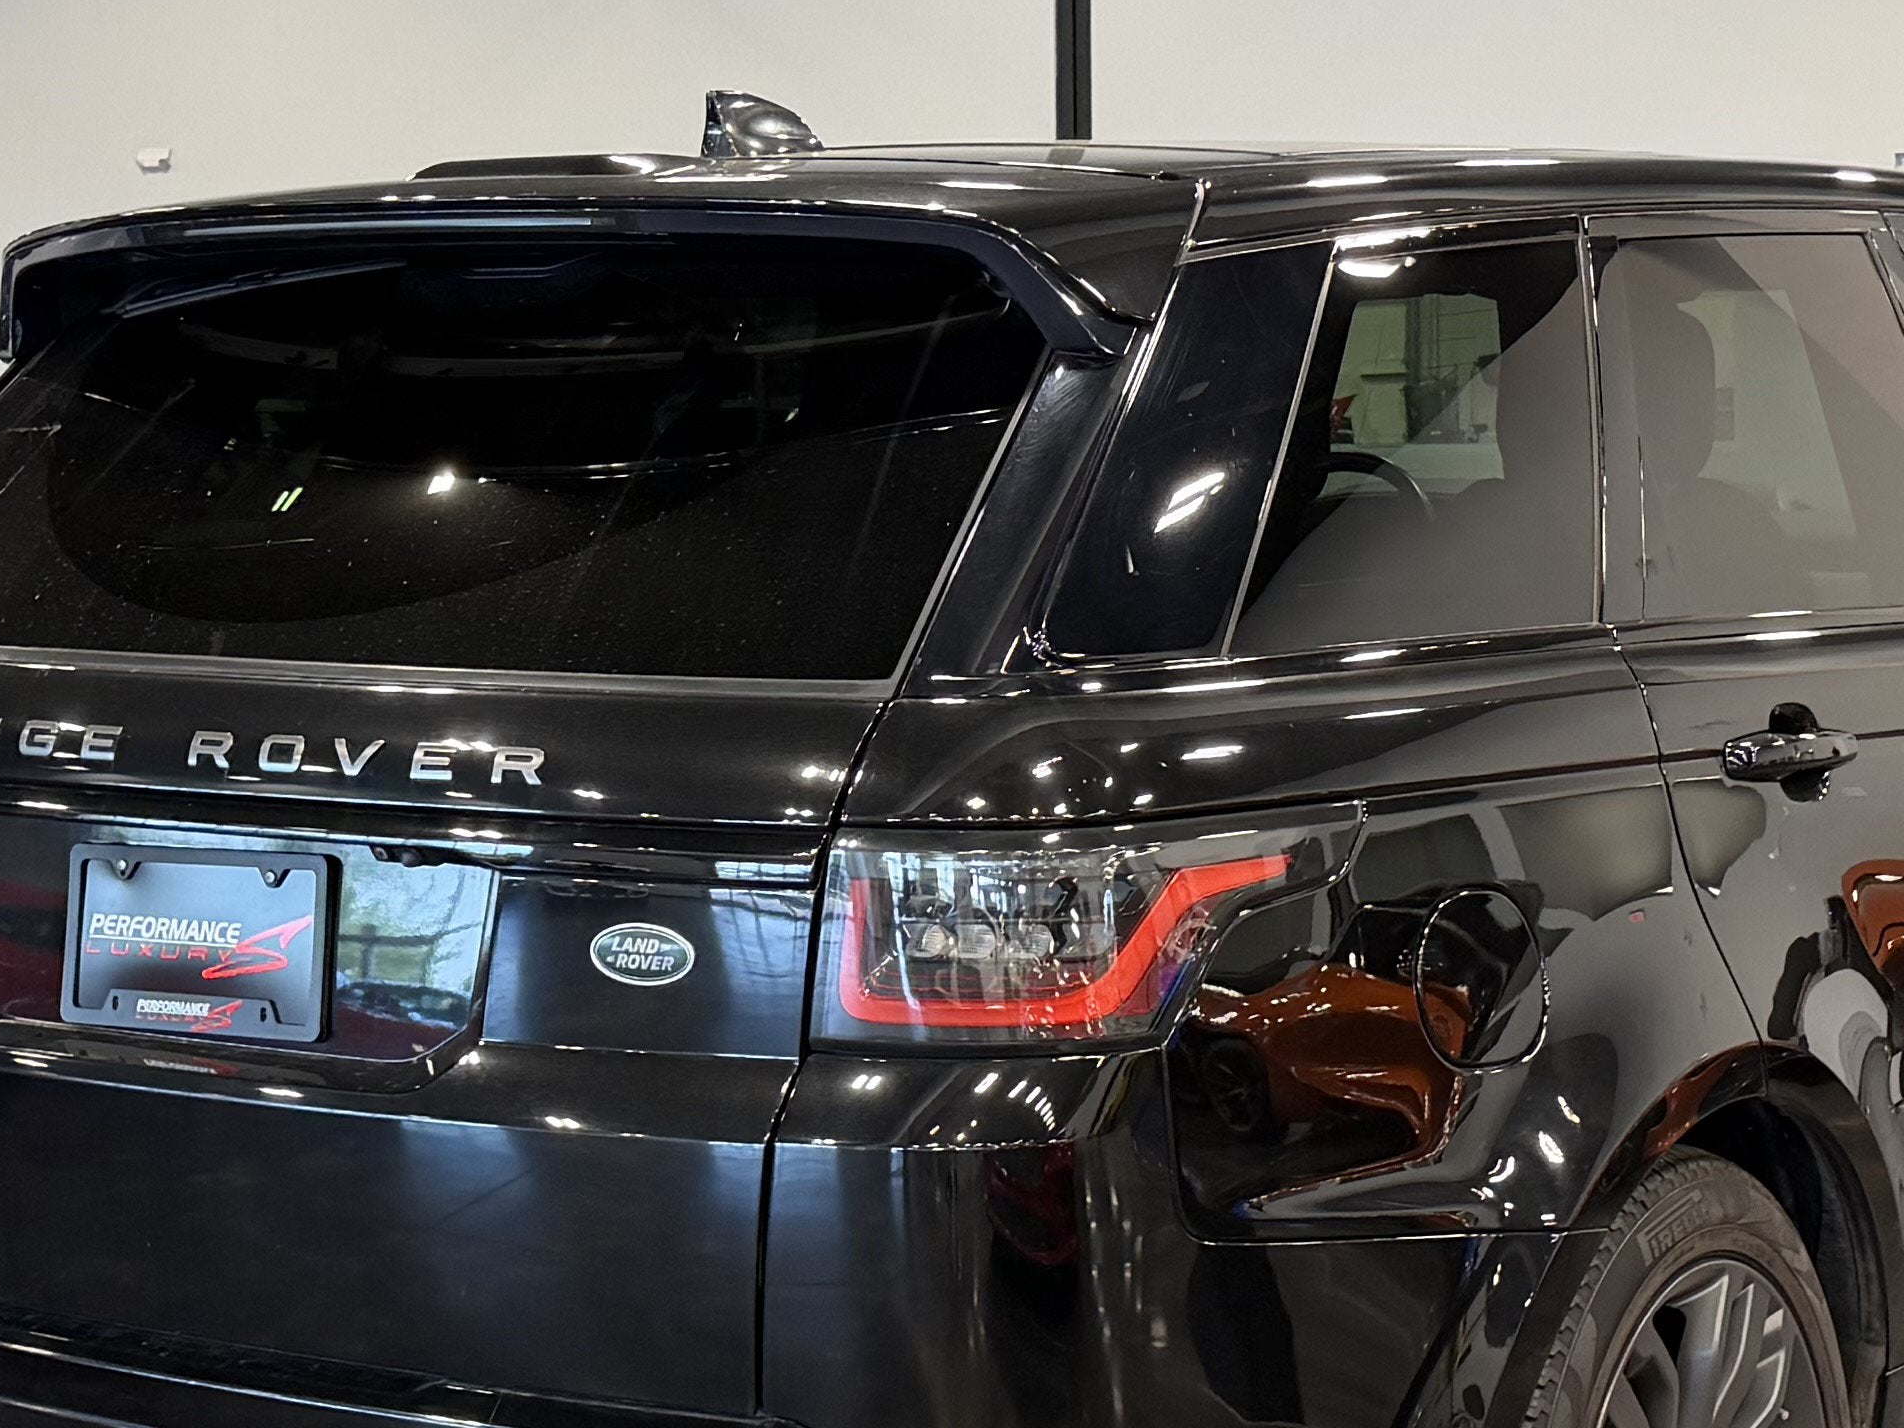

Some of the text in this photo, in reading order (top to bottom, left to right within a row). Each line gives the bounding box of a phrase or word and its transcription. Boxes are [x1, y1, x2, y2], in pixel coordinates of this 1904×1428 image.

[186, 729, 546, 786] ROVER
[88, 912, 243, 945] PERFORMANCE
[85, 939, 233, 963] LUXURY
[610, 935, 660, 955] LAND
[615, 953, 676, 972] ROVER
[136, 998, 212, 1017] PERFORMANCE
[1636, 1187, 1710, 1268] PIRE
